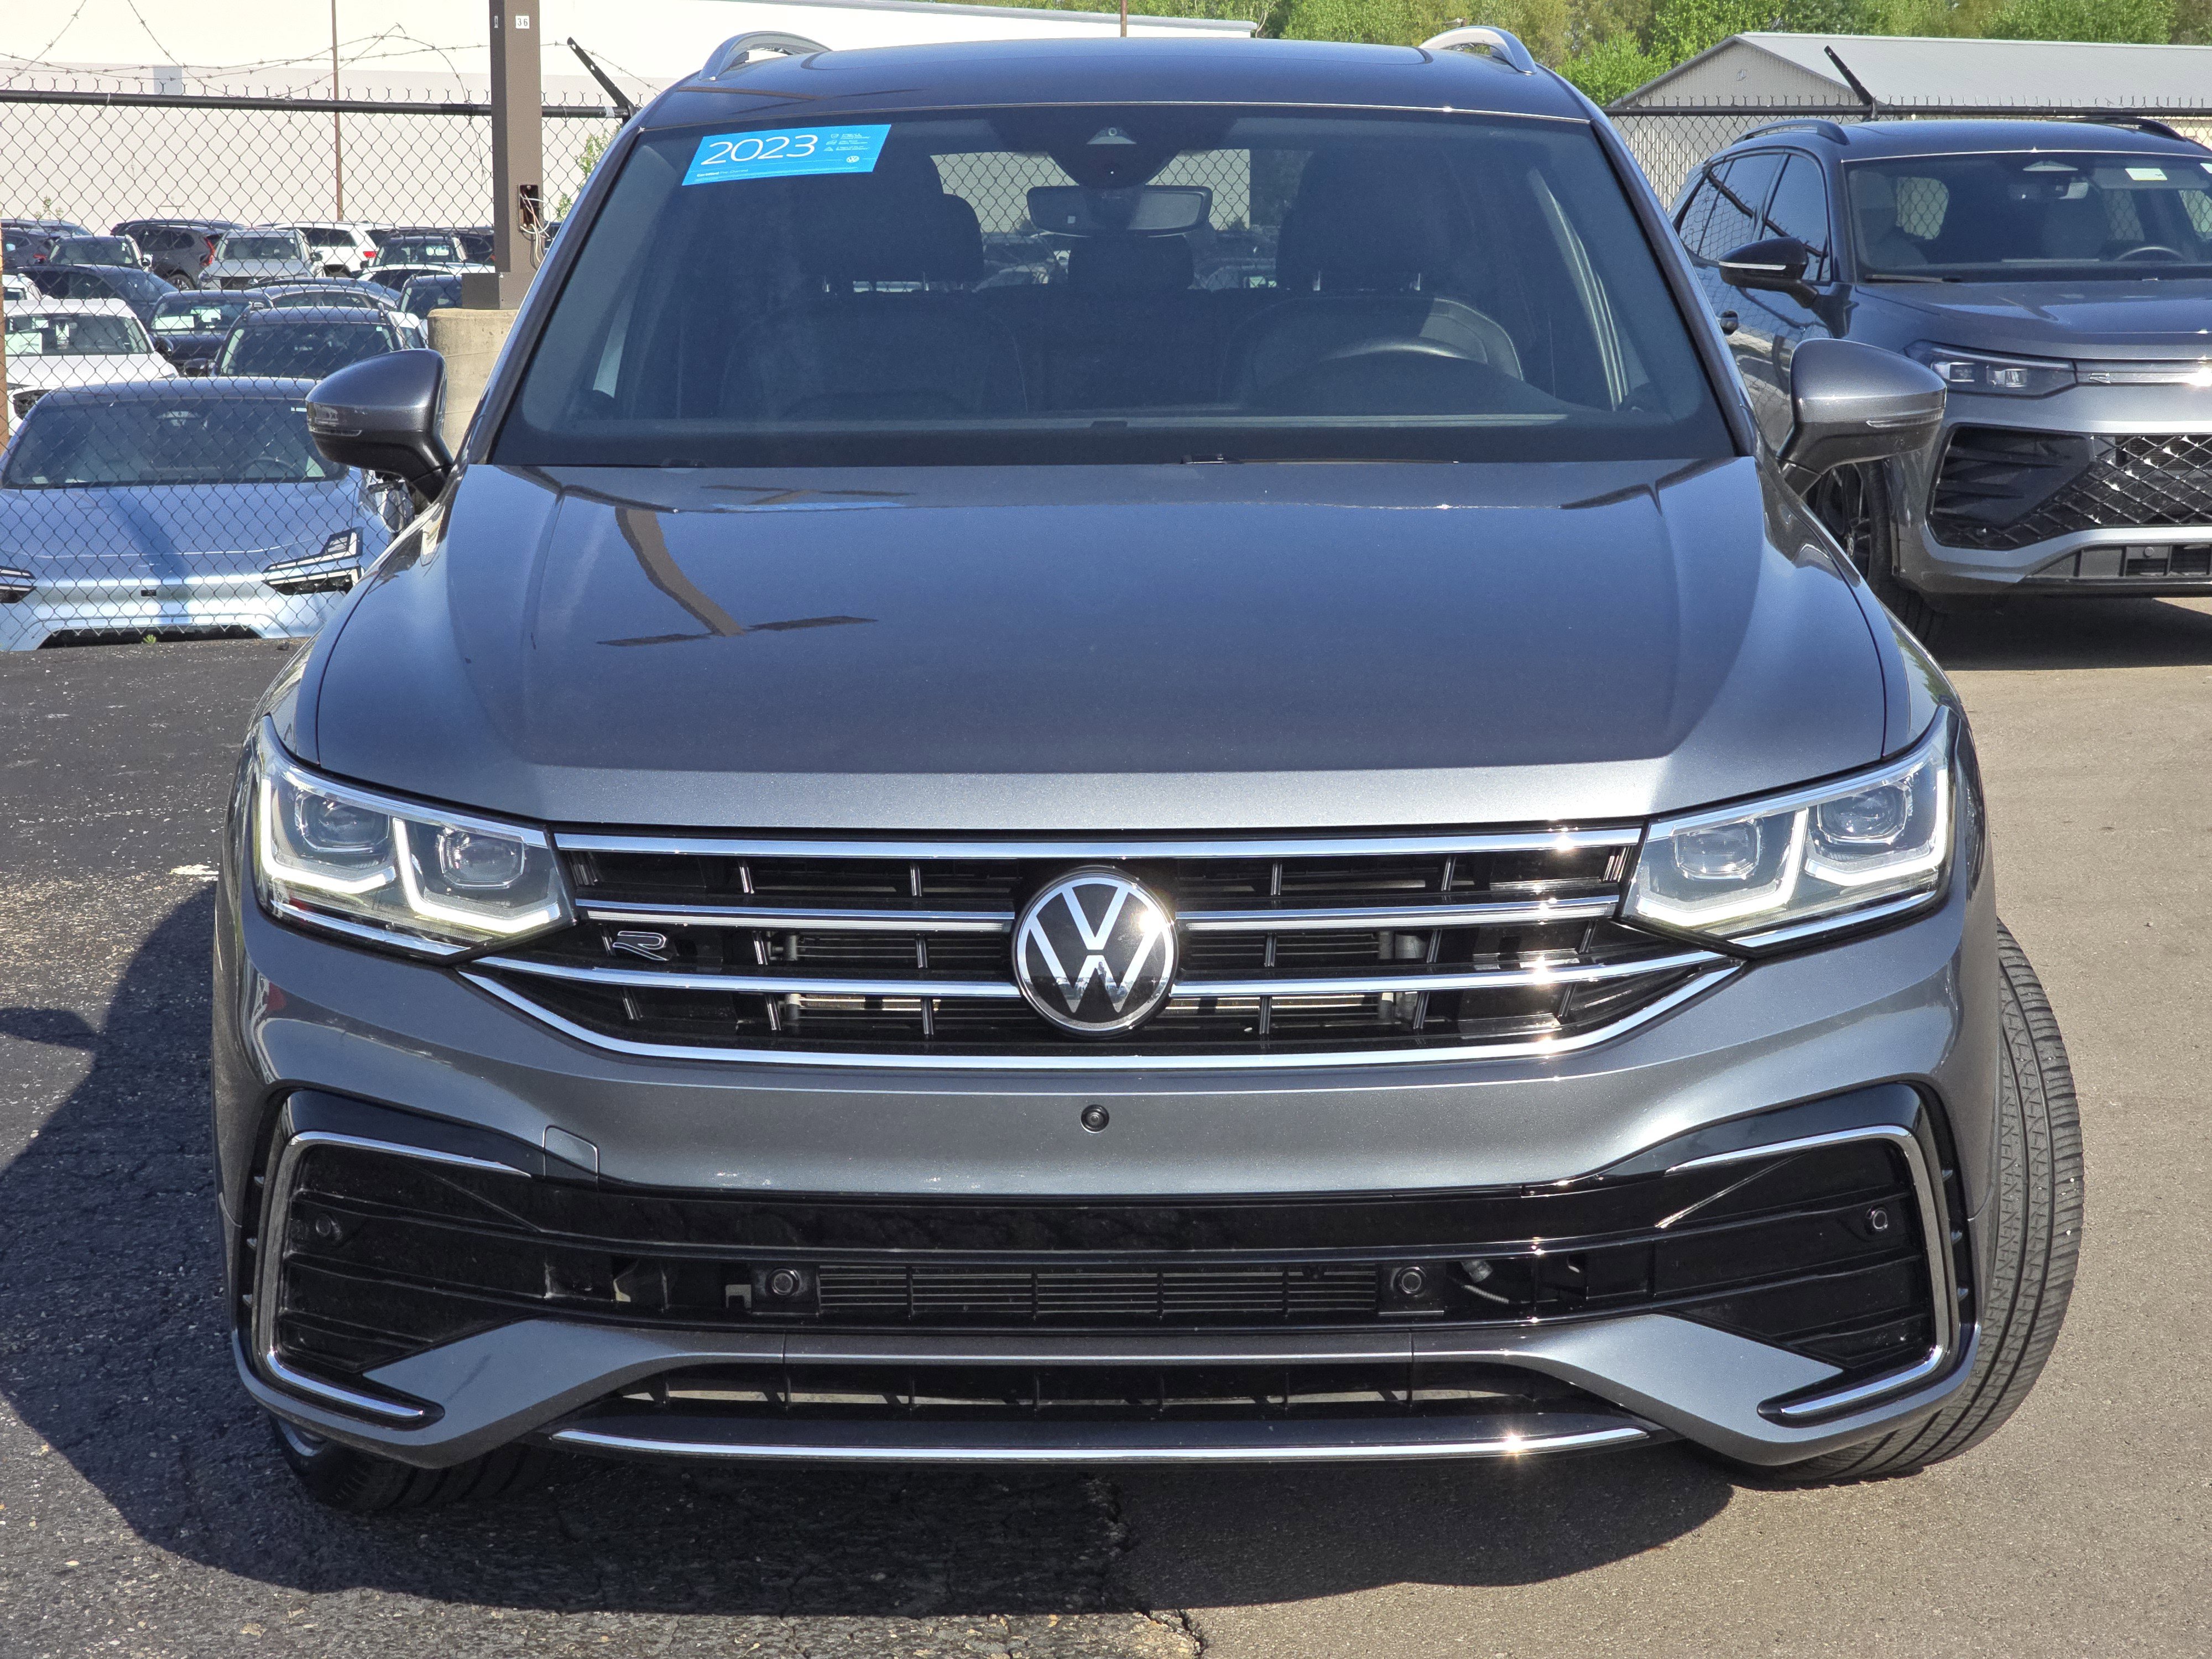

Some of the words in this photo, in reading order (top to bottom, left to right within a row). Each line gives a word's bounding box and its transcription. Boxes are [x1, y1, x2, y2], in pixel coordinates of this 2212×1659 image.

[517, 18, 528, 27] 36
[700, 134, 818, 165] 2023
[612, 931, 669, 961] R
[1019, 875, 1172, 1024] VW
